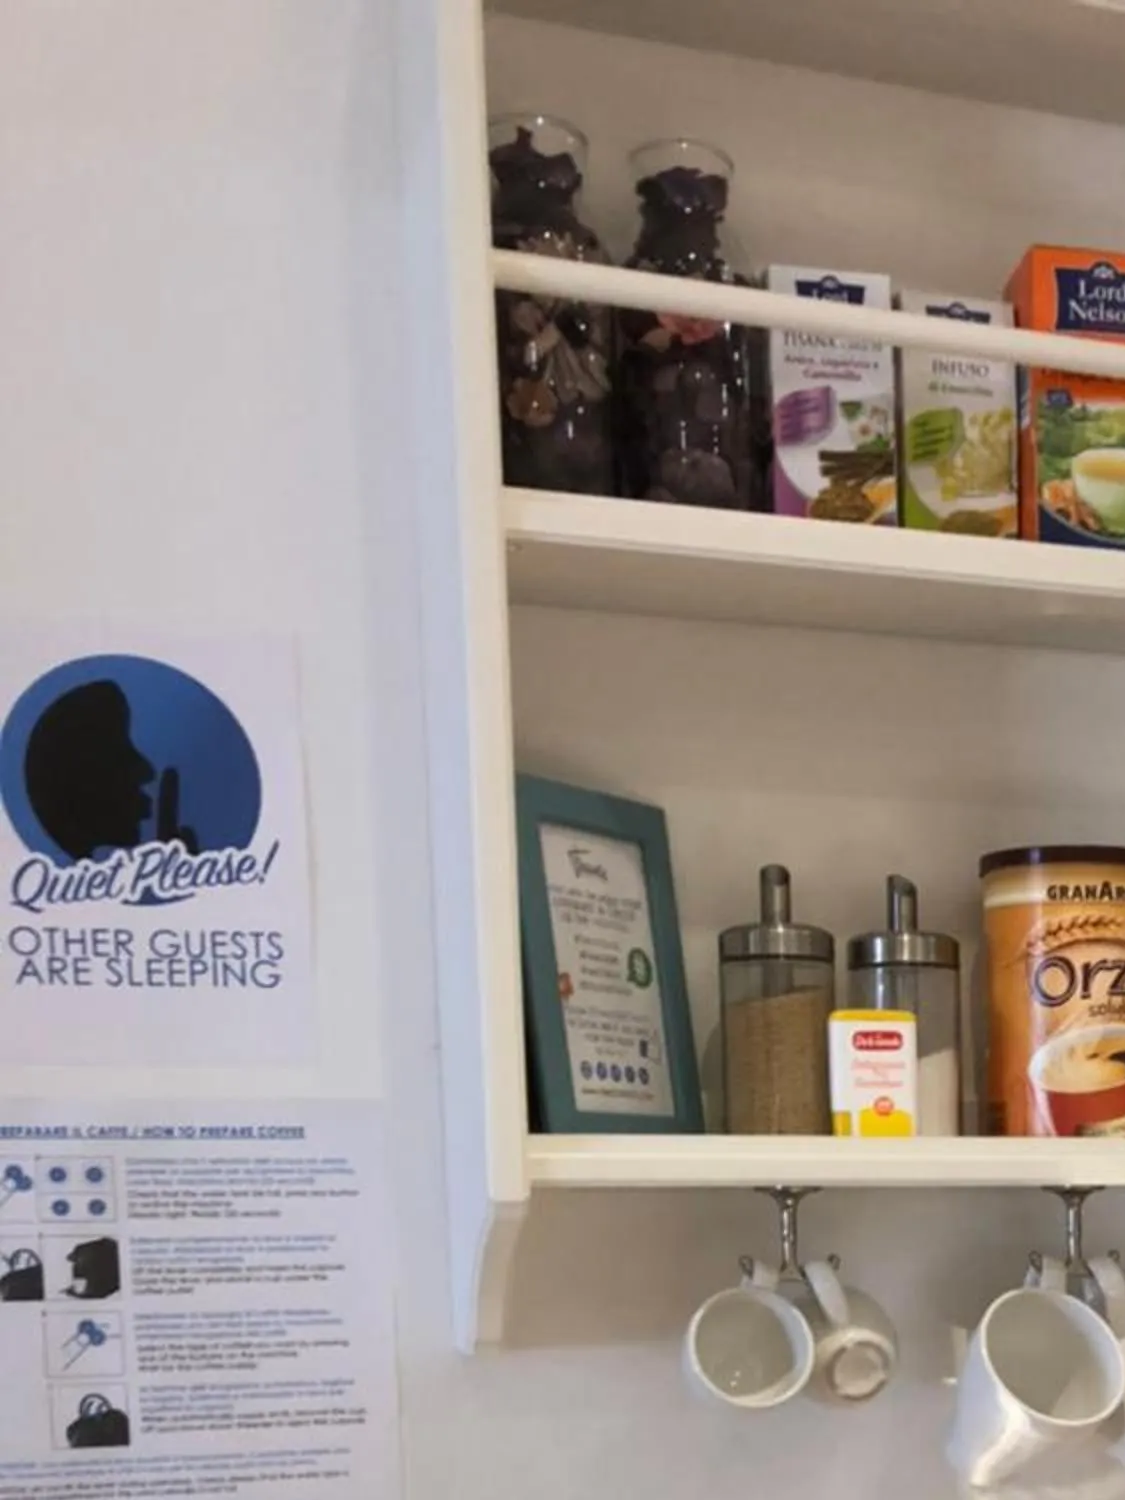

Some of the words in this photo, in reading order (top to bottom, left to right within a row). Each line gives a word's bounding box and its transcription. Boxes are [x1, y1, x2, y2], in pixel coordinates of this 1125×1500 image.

[931, 359, 990, 377] INFUSO
[11, 856, 124, 913] Quiet
[128, 839, 280, 897] Please!
[8, 925, 135, 958] OTHER
[149, 929, 285, 961] GUESTS
[16, 957, 93, 986] ARE
[105, 958, 281, 989] SLEEPING
[199, 1126, 253, 1140] PREPARE
